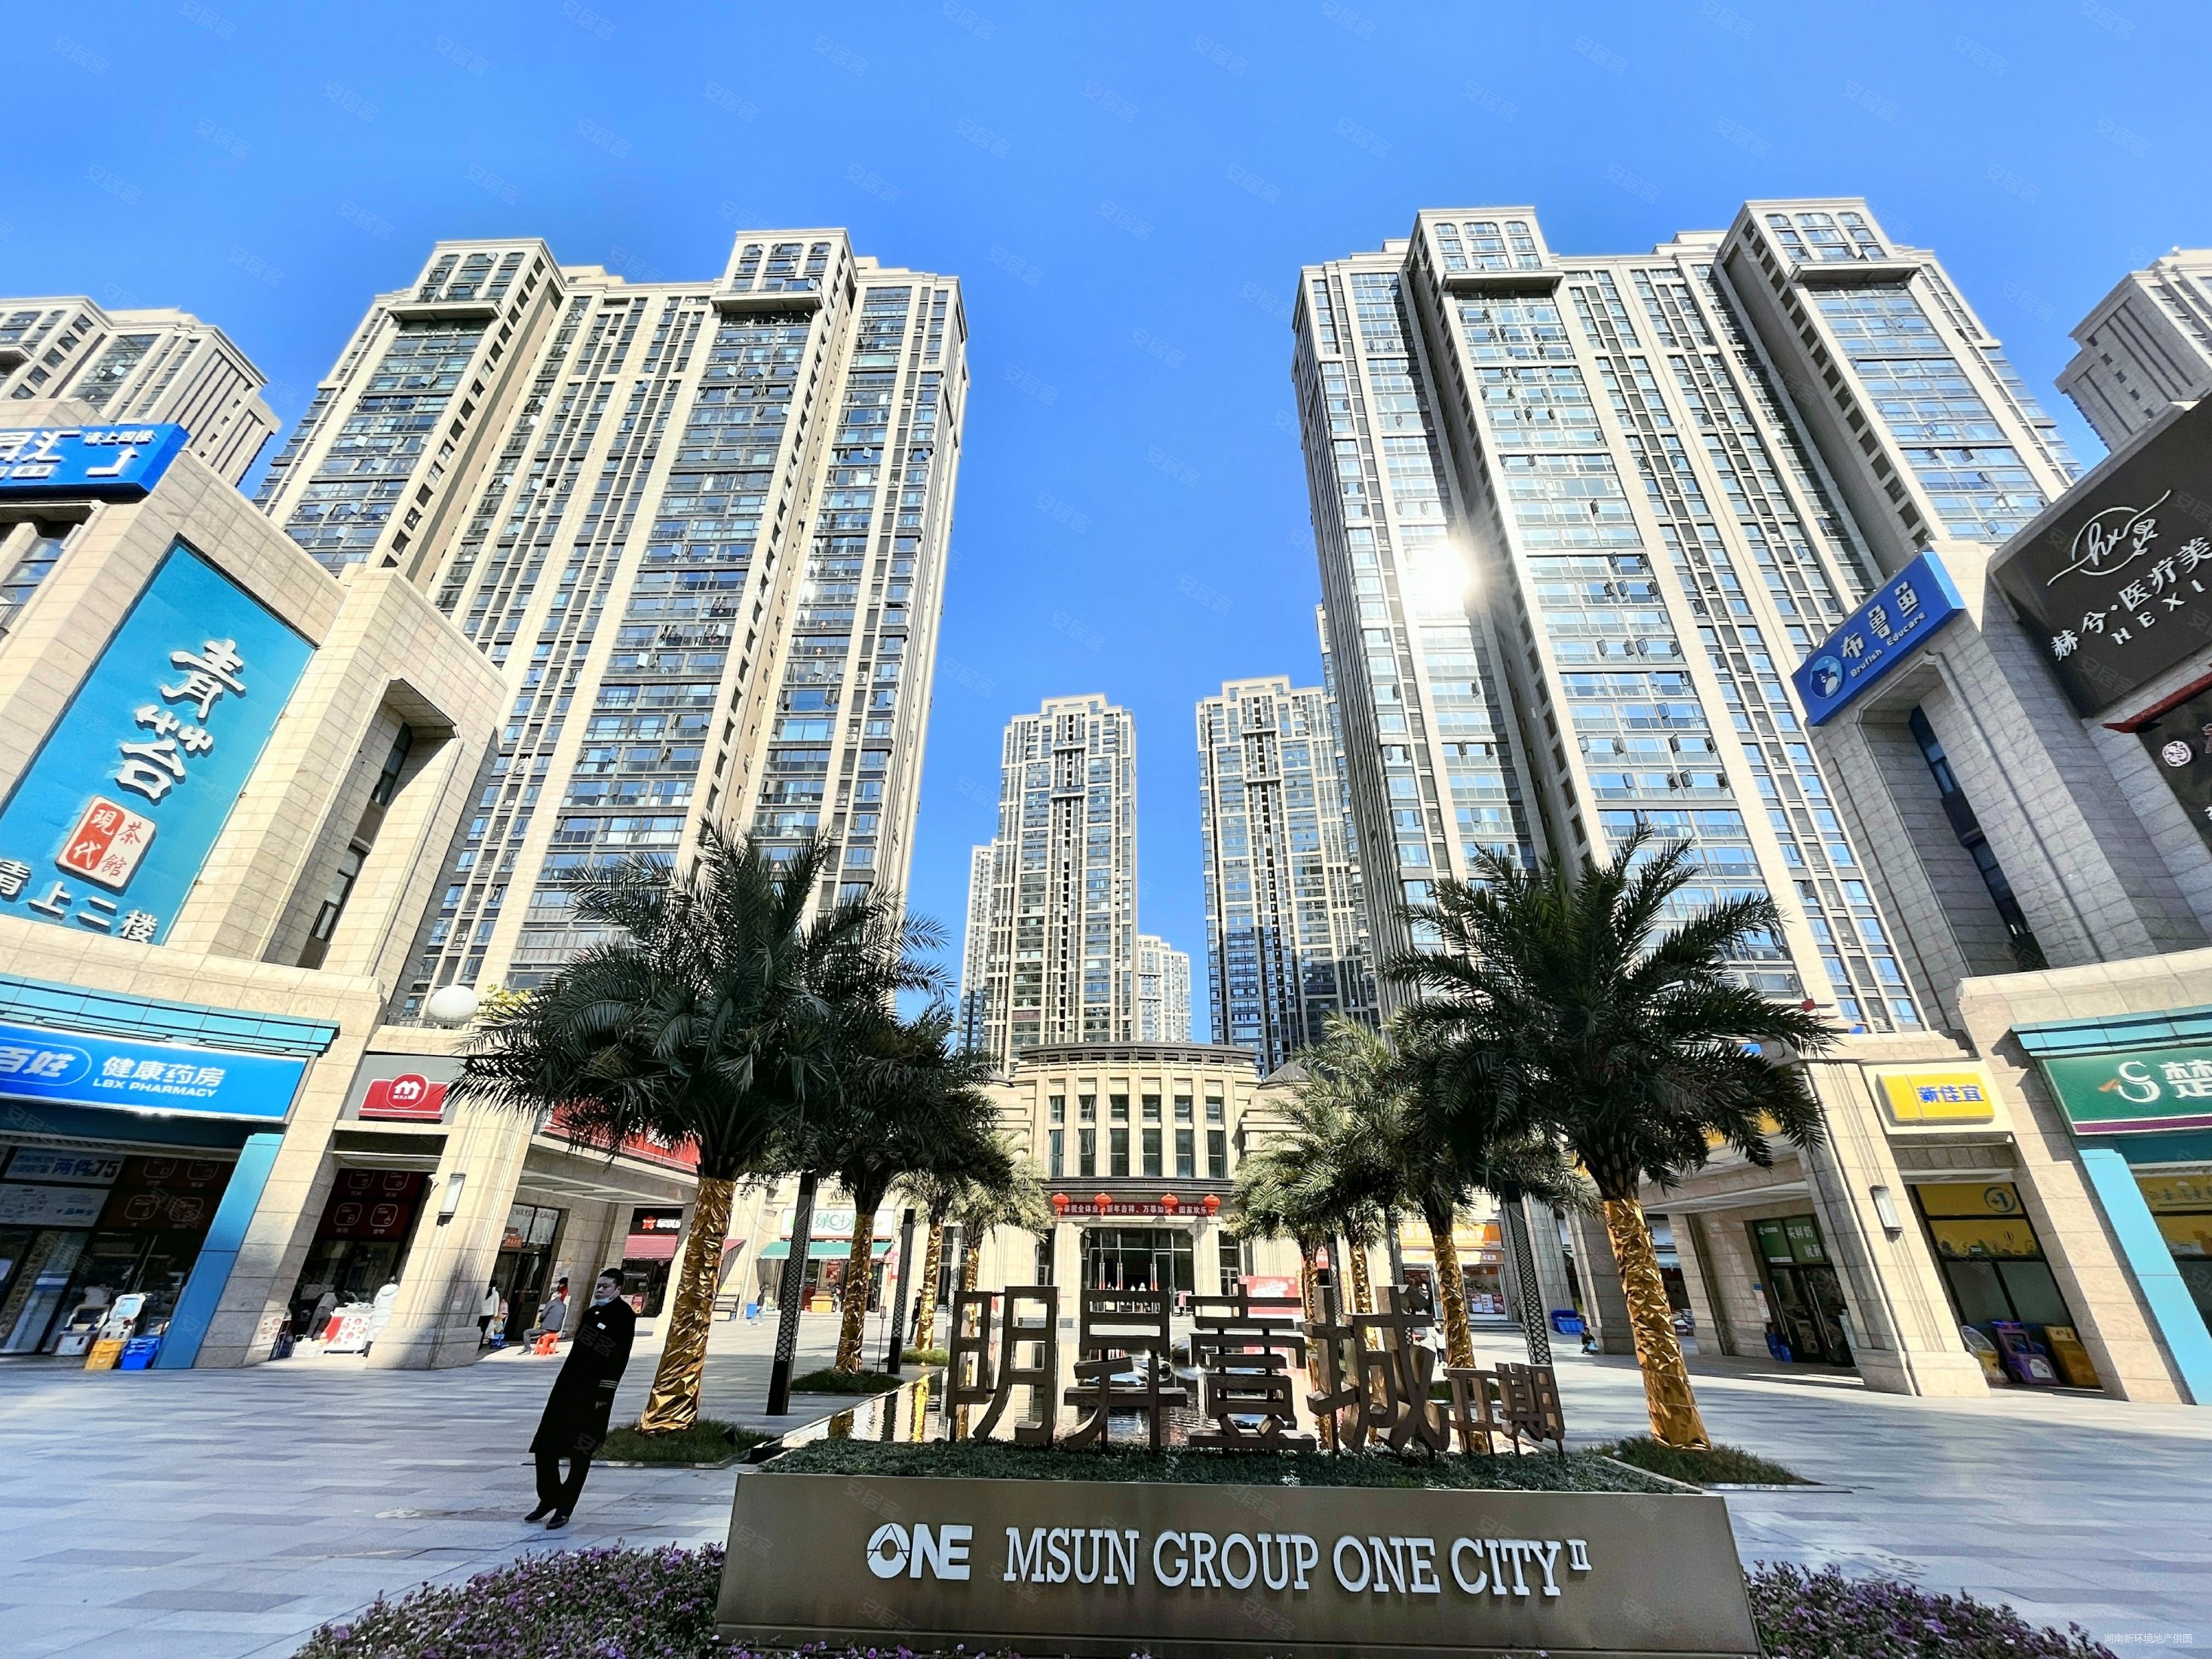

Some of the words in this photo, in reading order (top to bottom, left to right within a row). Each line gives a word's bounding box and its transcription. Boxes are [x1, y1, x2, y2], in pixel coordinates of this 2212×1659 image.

[1841, 581, 1919, 658] 布鲁鱼
[1886, 612, 1925, 646] Educare
[103, 1055, 225, 1087] 健康药房
[92, 1078, 126, 1090] LBX
[128, 1080, 219, 1098] PHARMACY
[1917, 1084, 1985, 1104] 新佳宜
[867, 1522, 973, 1581] ONE
[1002, 1526, 1140, 1586] MSUN
[1152, 1529, 1318, 1591] GROUP
[1333, 1535, 1440, 1594] ONE
[1451, 1537, 1562, 1597] CITY
